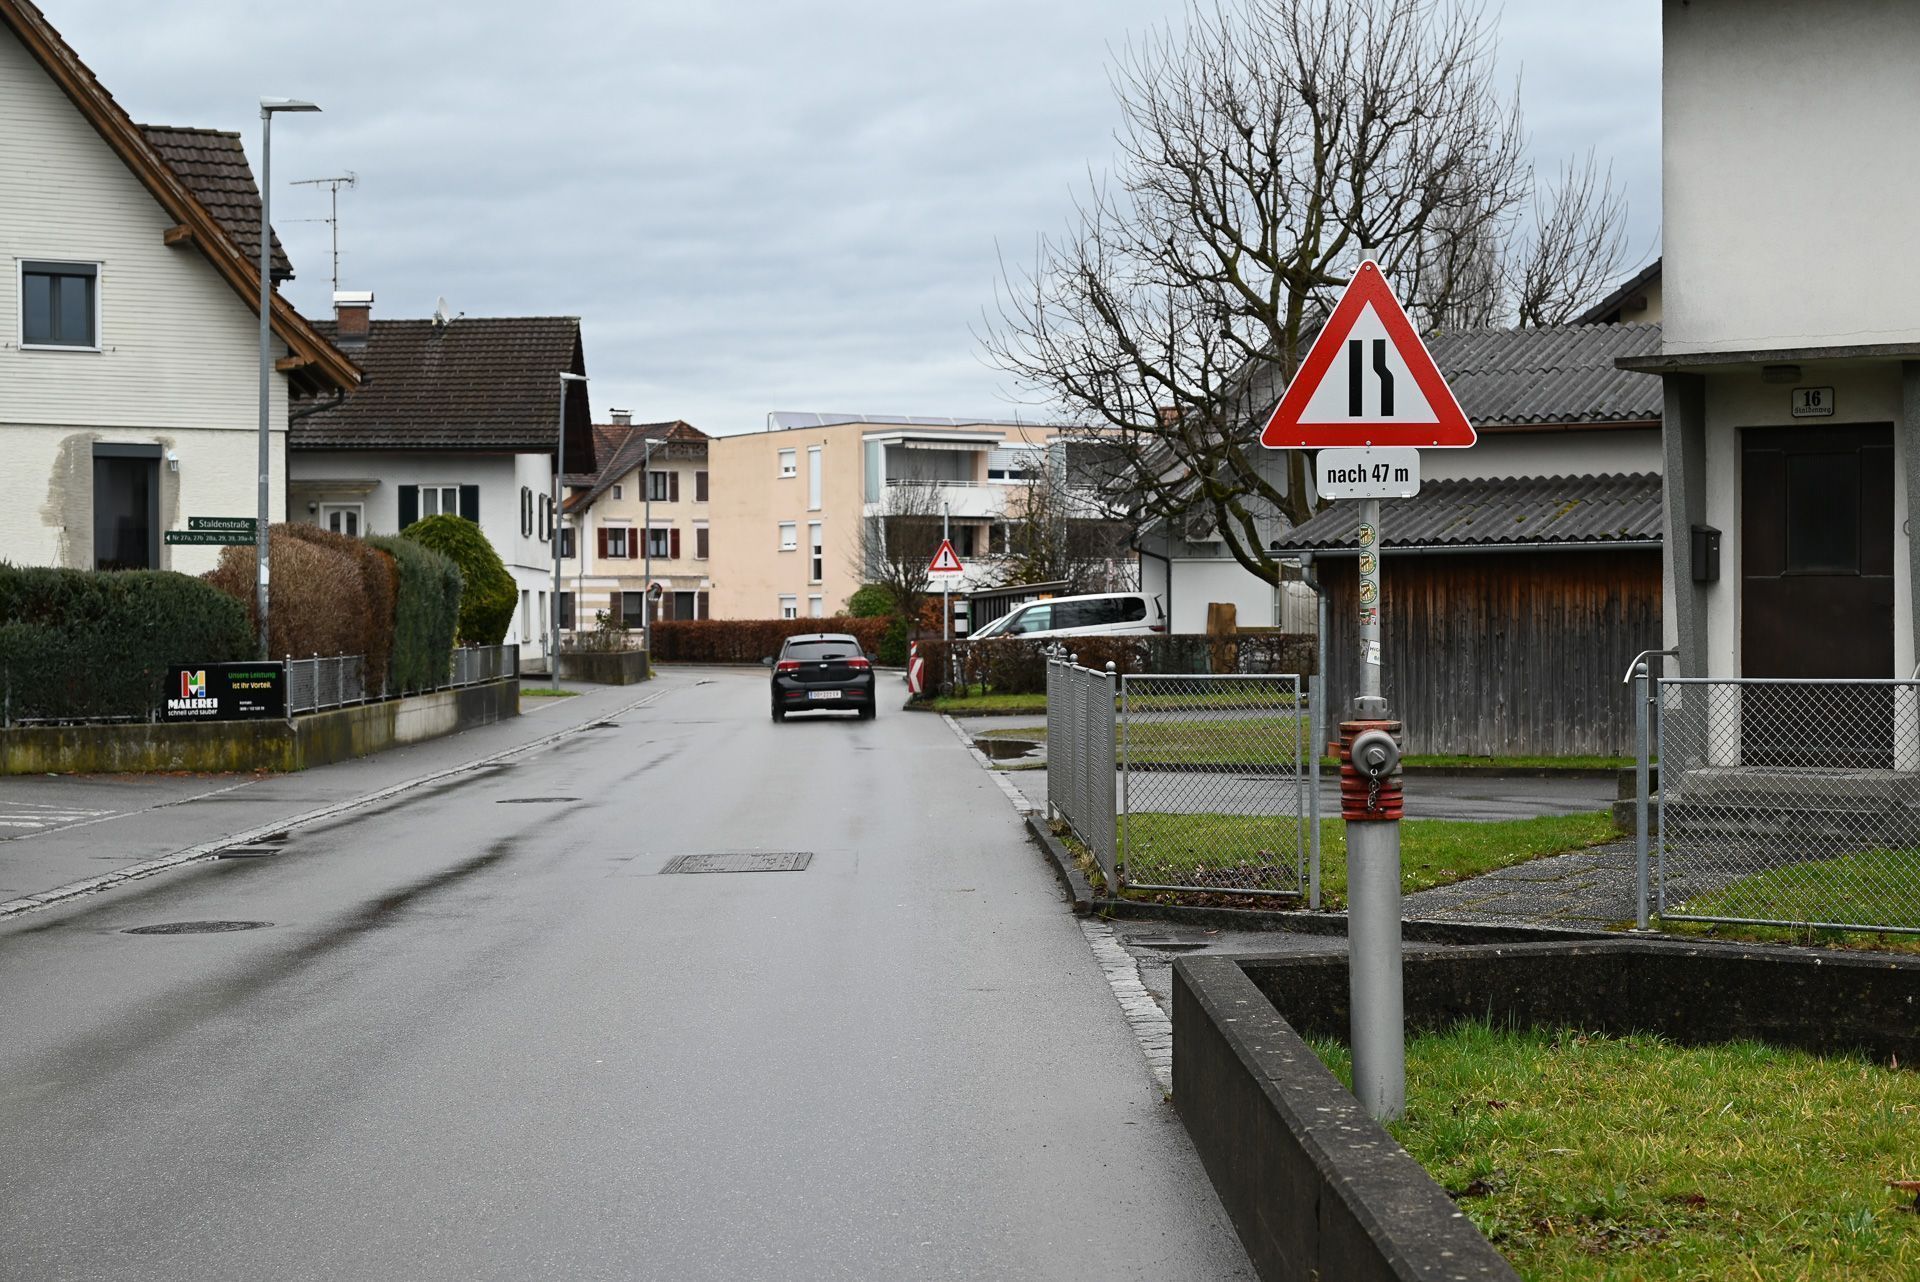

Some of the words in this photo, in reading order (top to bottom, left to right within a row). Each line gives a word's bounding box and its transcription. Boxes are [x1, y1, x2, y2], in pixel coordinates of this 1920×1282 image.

[1803, 390, 1822, 407] 16
[1327, 463, 1367, 483] nach
[1372, 463, 1390, 482] 47
[1394, 467, 1409, 482] m
[198, 519, 250, 529] Staldenstraße
[168, 698, 218, 710] MALEREI
